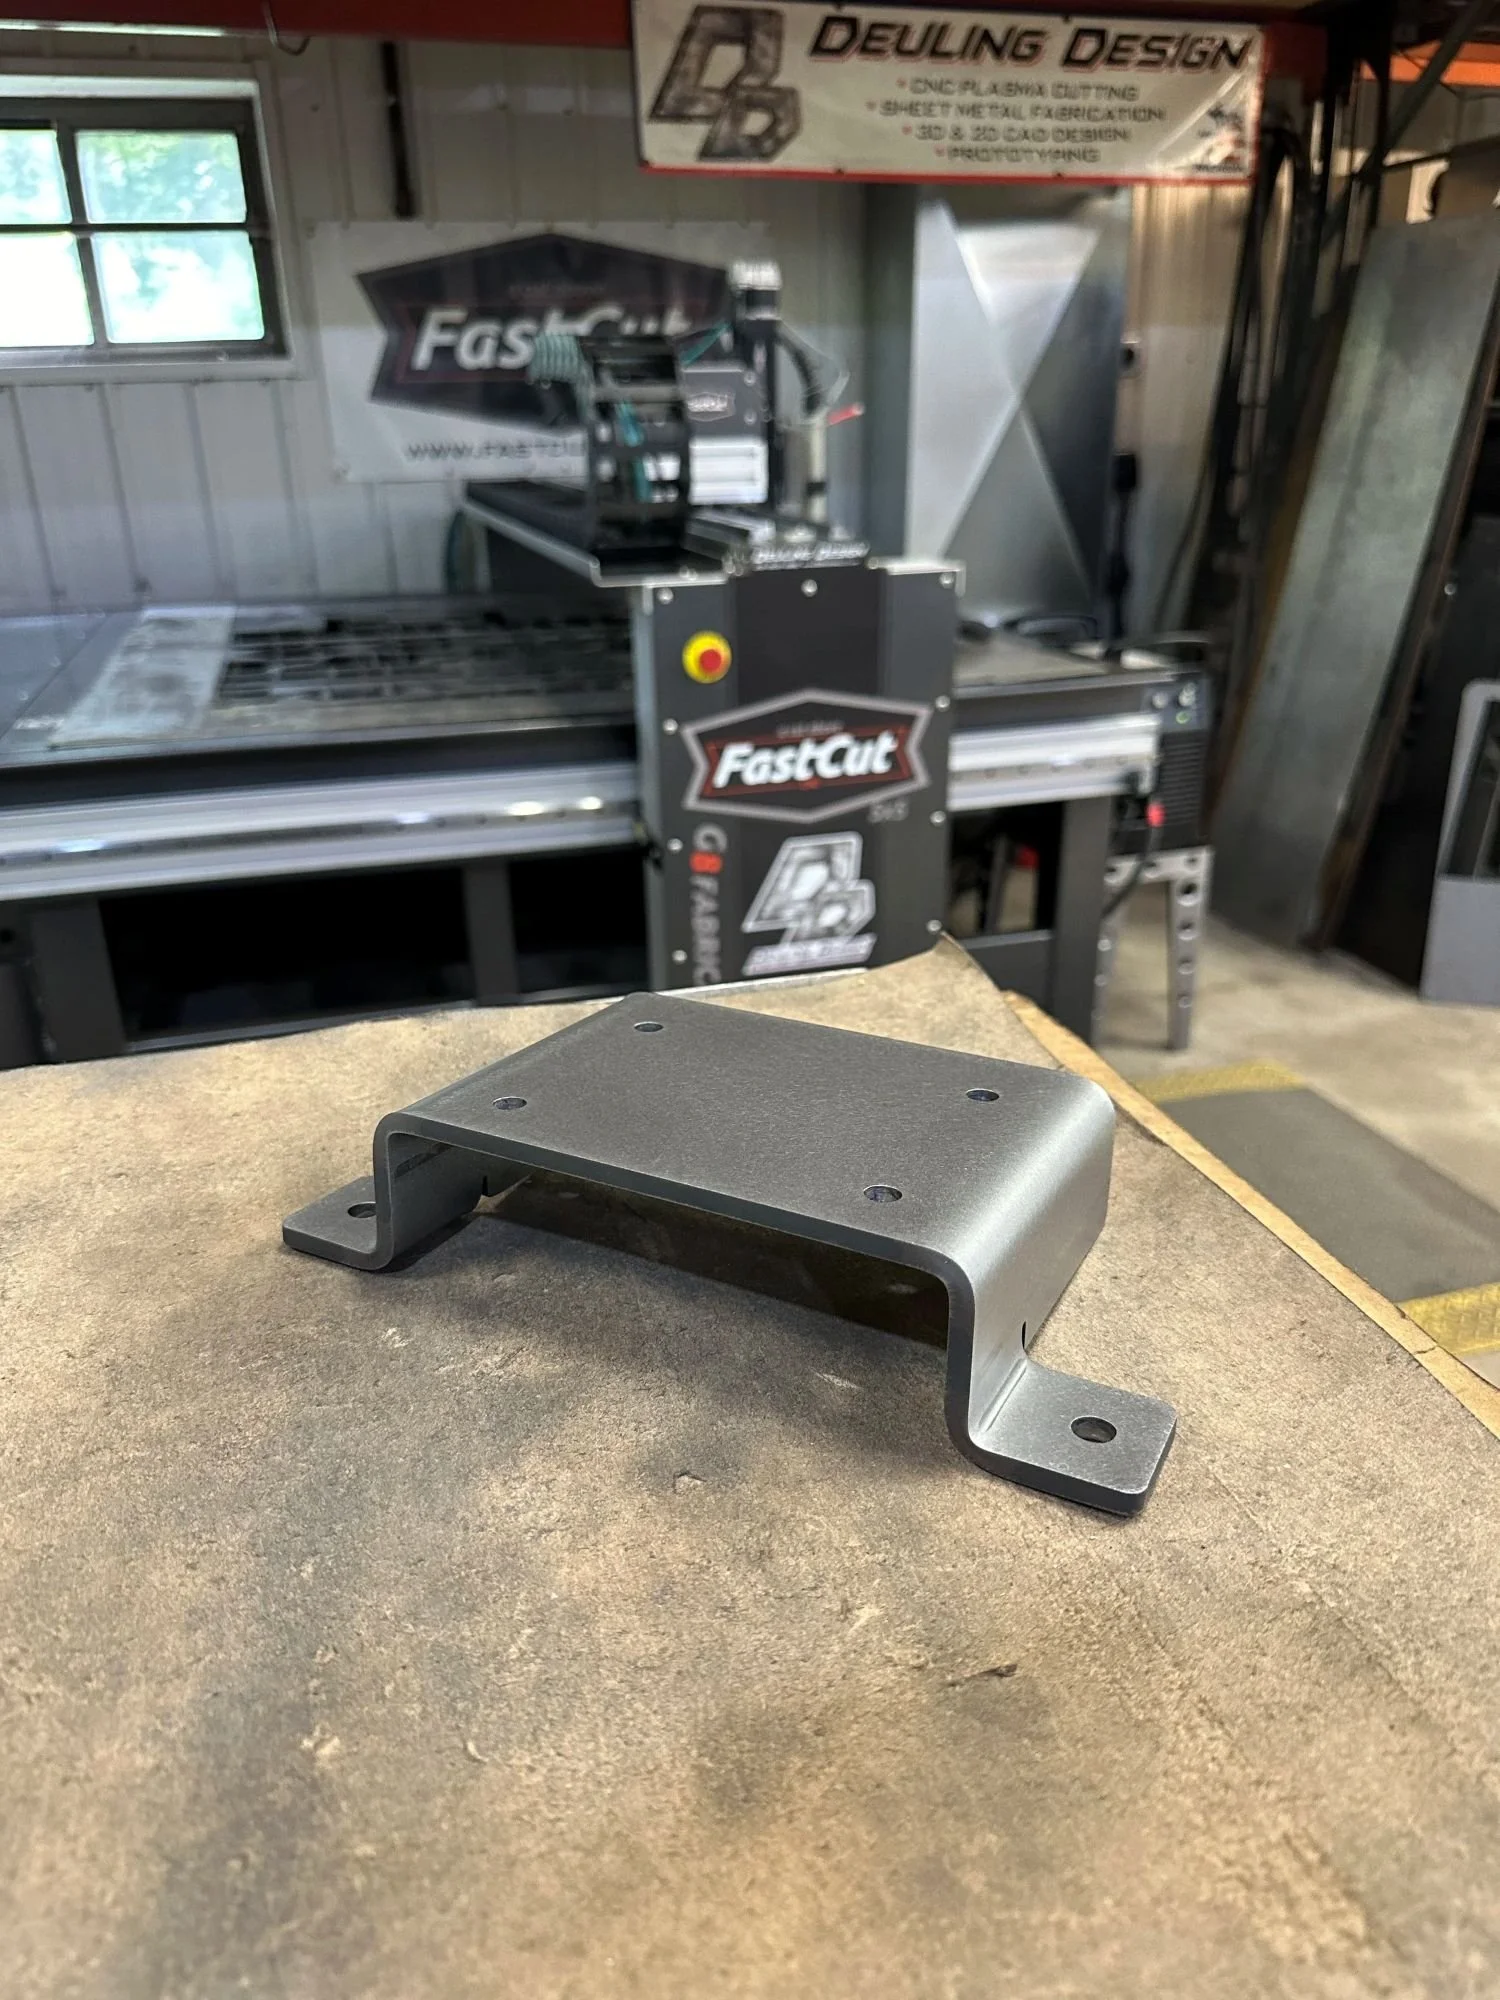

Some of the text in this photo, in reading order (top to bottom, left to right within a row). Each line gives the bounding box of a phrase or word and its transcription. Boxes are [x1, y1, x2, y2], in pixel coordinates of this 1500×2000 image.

[1060, 27, 1253, 71] DESIGN
[909, 77, 1140, 101] CNC PLASMA CUTTING
[879, 100, 1166, 122] SHEET METAL FABRICATION
[914, 124, 947, 141] 3D
[970, 125, 1000, 142] 2D
[1002, 126, 1049, 143] CAD
[1052, 127, 1132, 143] DESIGN
[947, 146, 1100, 163] PROTOTYPING
[713, 730, 898, 788] FastCut
